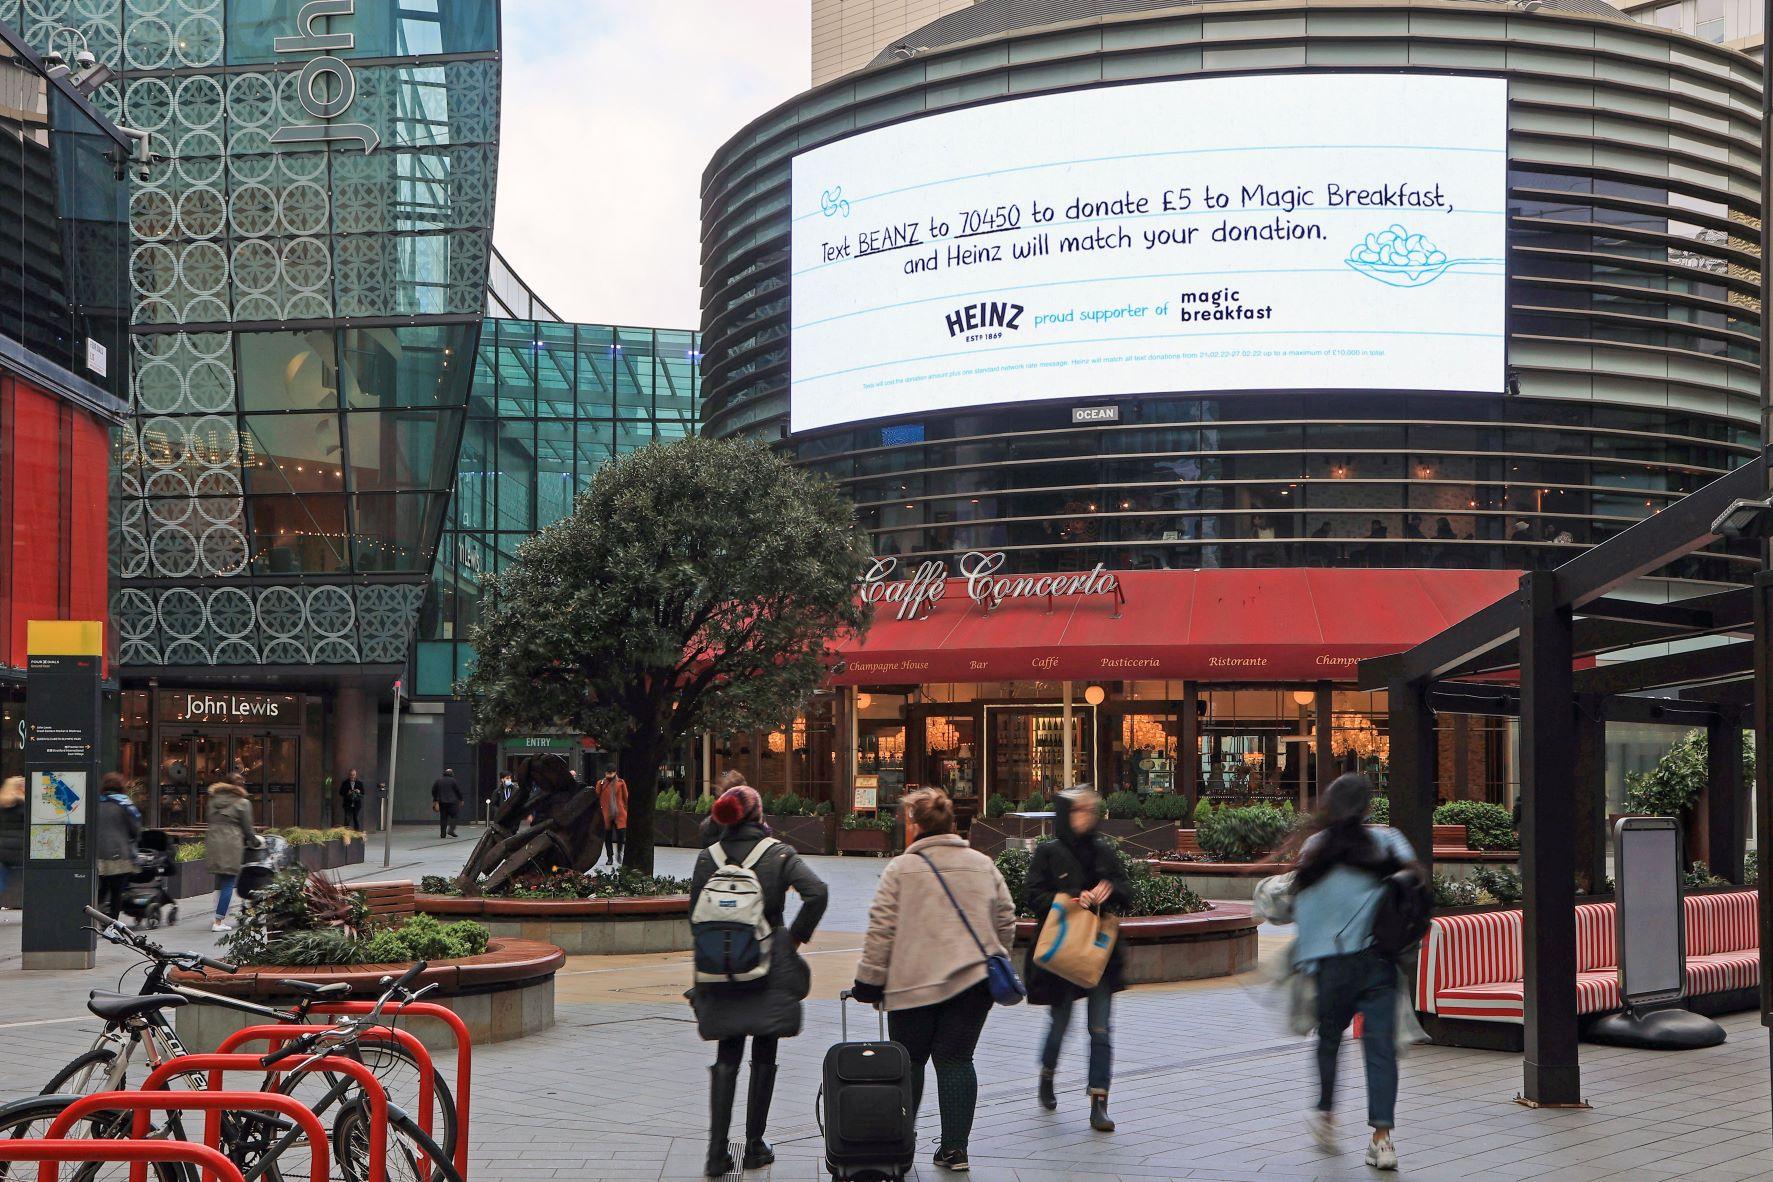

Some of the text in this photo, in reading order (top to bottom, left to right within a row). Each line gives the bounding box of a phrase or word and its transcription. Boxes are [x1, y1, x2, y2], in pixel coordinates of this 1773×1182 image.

[822, 182, 1453, 263] Text BEANZ to 70450 to donate £5 to Magic Breakfast,
[903, 216, 1327, 275] and Heinz will match your donation.
[1181, 288, 1240, 308] magic
[1034, 301, 1170, 329] proud supporter of
[1181, 303, 1273, 322] breakfast
[945, 301, 1025, 338] HEINZ
[985, 332, 1003, 341] 1869
[1076, 408, 1114, 420] OCEAN
[860, 551, 1119, 621] Caffé Concerto
[849, 660, 929, 673] Champagne House
[969, 660, 989, 670] Bar
[1031, 656, 1059, 669] Caffé
[1100, 656, 1160, 667] Pasticceria
[1208, 656, 1267, 666] Ristorante
[1315, 655, 1361, 668] Champa
[184, 694, 279, 719] John Lewis
[526, 737, 551, 747] ENTRY
